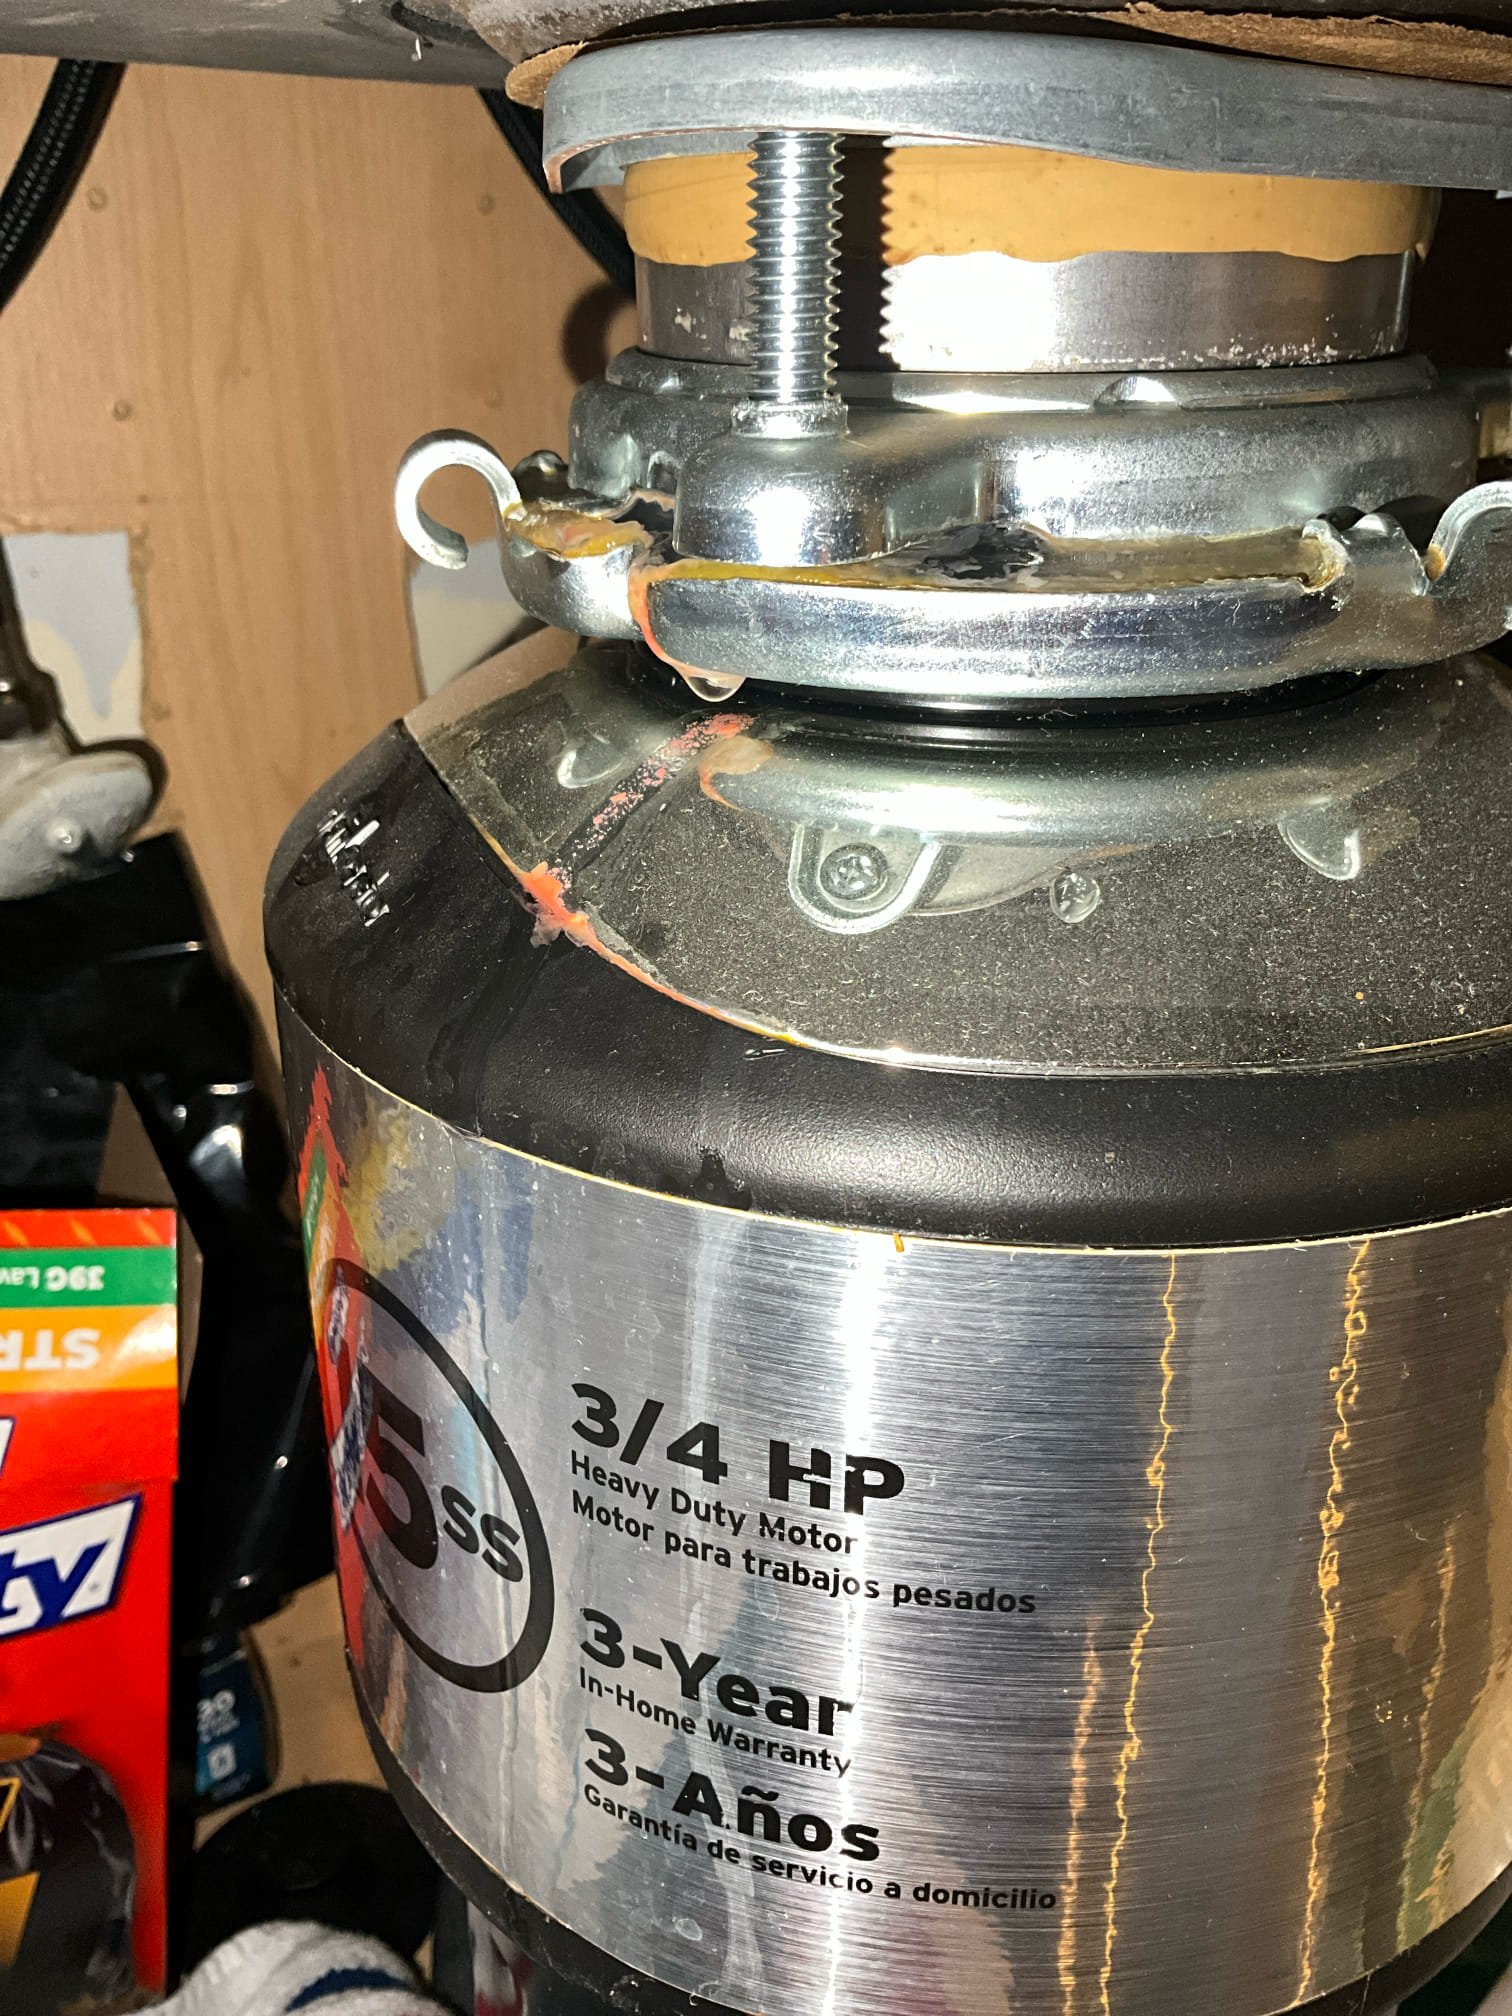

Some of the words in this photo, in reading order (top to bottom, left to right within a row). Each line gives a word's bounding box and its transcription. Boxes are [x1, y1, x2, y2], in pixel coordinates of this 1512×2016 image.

[571, 1383, 728, 1485] 3/4
[768, 1439, 905, 1516] HP
[571, 1450, 659, 1510] Heavy
[671, 1488, 746, 1536] Duty
[759, 1512, 858, 1553] Motor
[572, 1489, 654, 1541] Motor
[664, 1530, 731, 1568] para
[742, 1549, 880, 1598] trabajos
[893, 1581, 1036, 1615] pesados
[579, 1608, 855, 1736] 3-Year
[579, 1667, 696, 1735] In-Home
[707, 1719, 852, 1778] Warranty
[584, 1728, 881, 1861] 3-Años
[584, 1784, 698, 1851] Garantía
[706, 1839, 741, 1864] de
[752, 1855, 873, 1894] servicio
[883, 1880, 901, 1899] a
[912, 1882, 1057, 1910] domicilio
